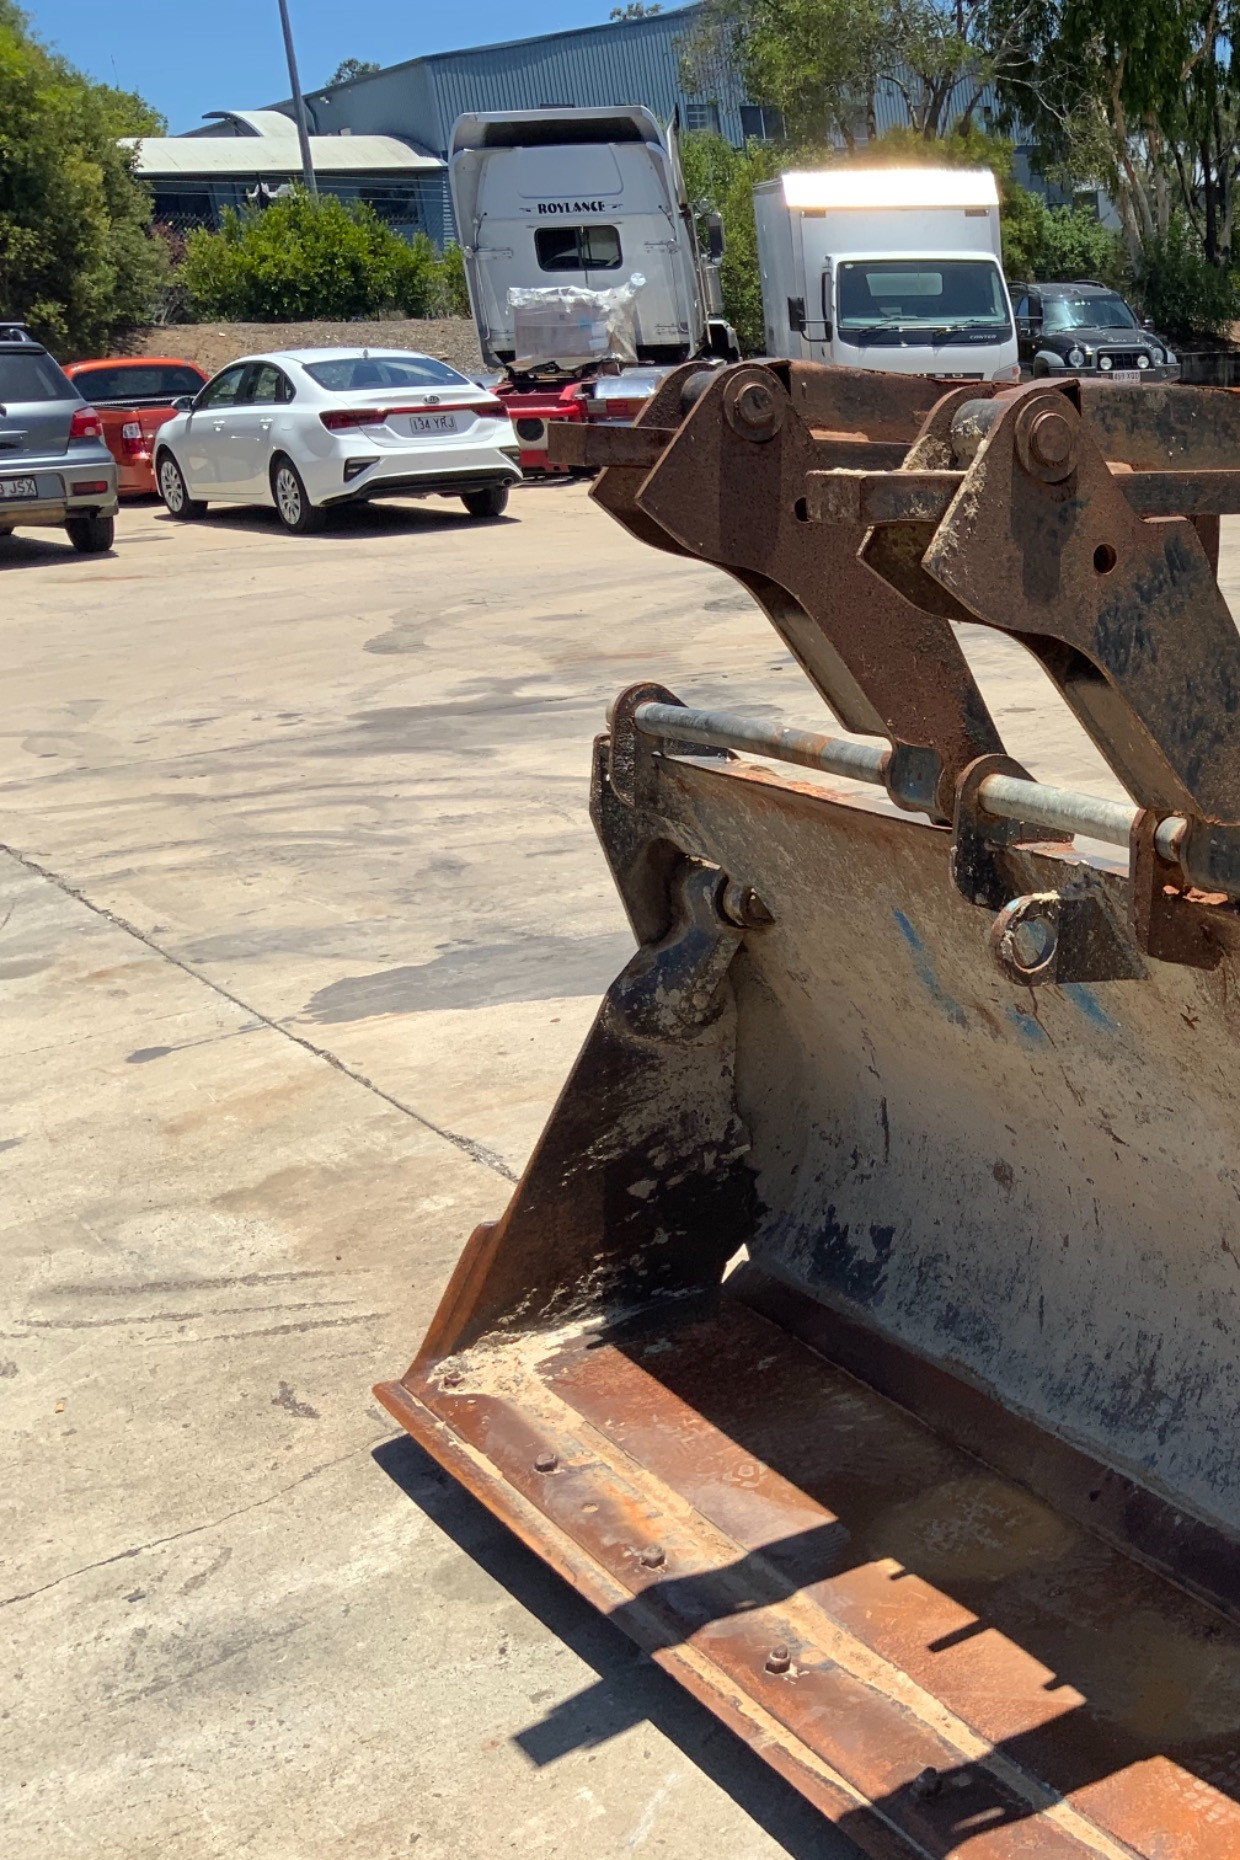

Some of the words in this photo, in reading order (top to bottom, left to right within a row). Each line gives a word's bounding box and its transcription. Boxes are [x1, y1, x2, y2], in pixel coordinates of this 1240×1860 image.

[537, 201, 605, 214] ROYLANCE
[413, 417, 431, 430] 134
[433, 416, 455, 429] YRJ
[10, 480, 35, 494] JSX
